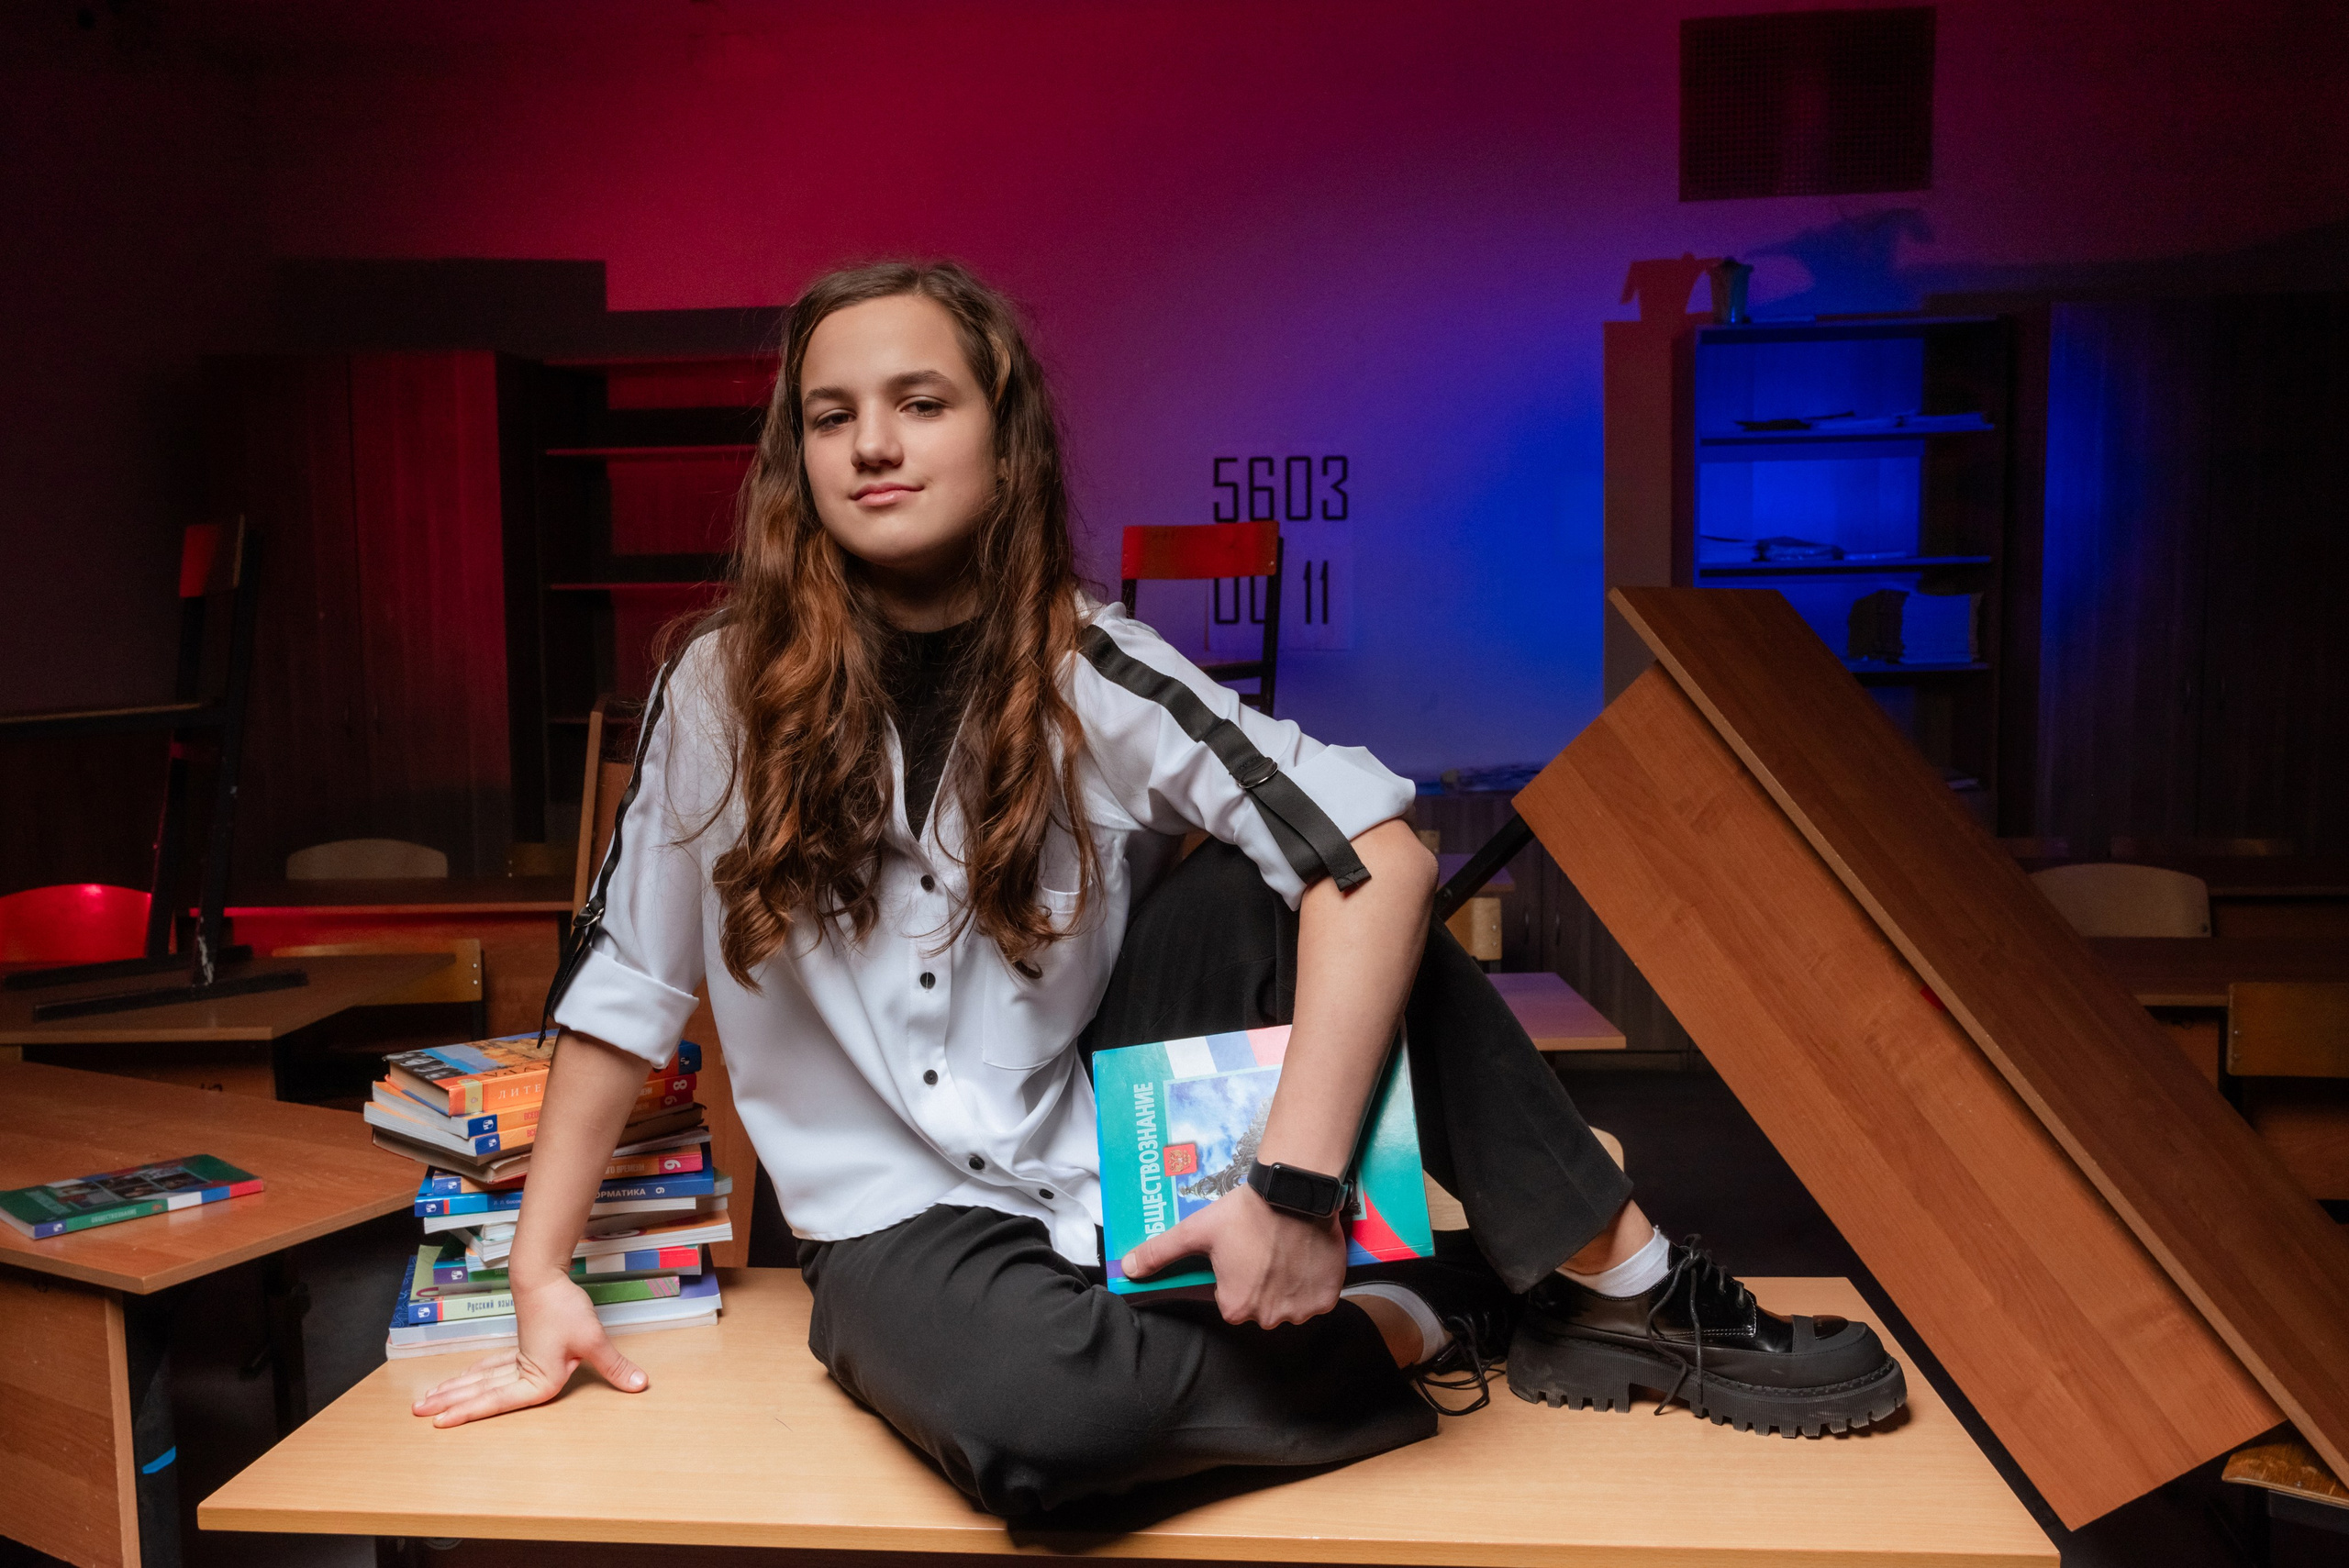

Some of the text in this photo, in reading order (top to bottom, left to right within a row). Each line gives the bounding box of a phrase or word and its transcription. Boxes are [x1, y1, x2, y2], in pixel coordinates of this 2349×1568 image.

[1213, 455, 1348, 523] 5603
[1303, 560, 1329, 625] 11
[673, 1079, 687, 1091] 8
[467, 1300, 494, 1312] Русский
